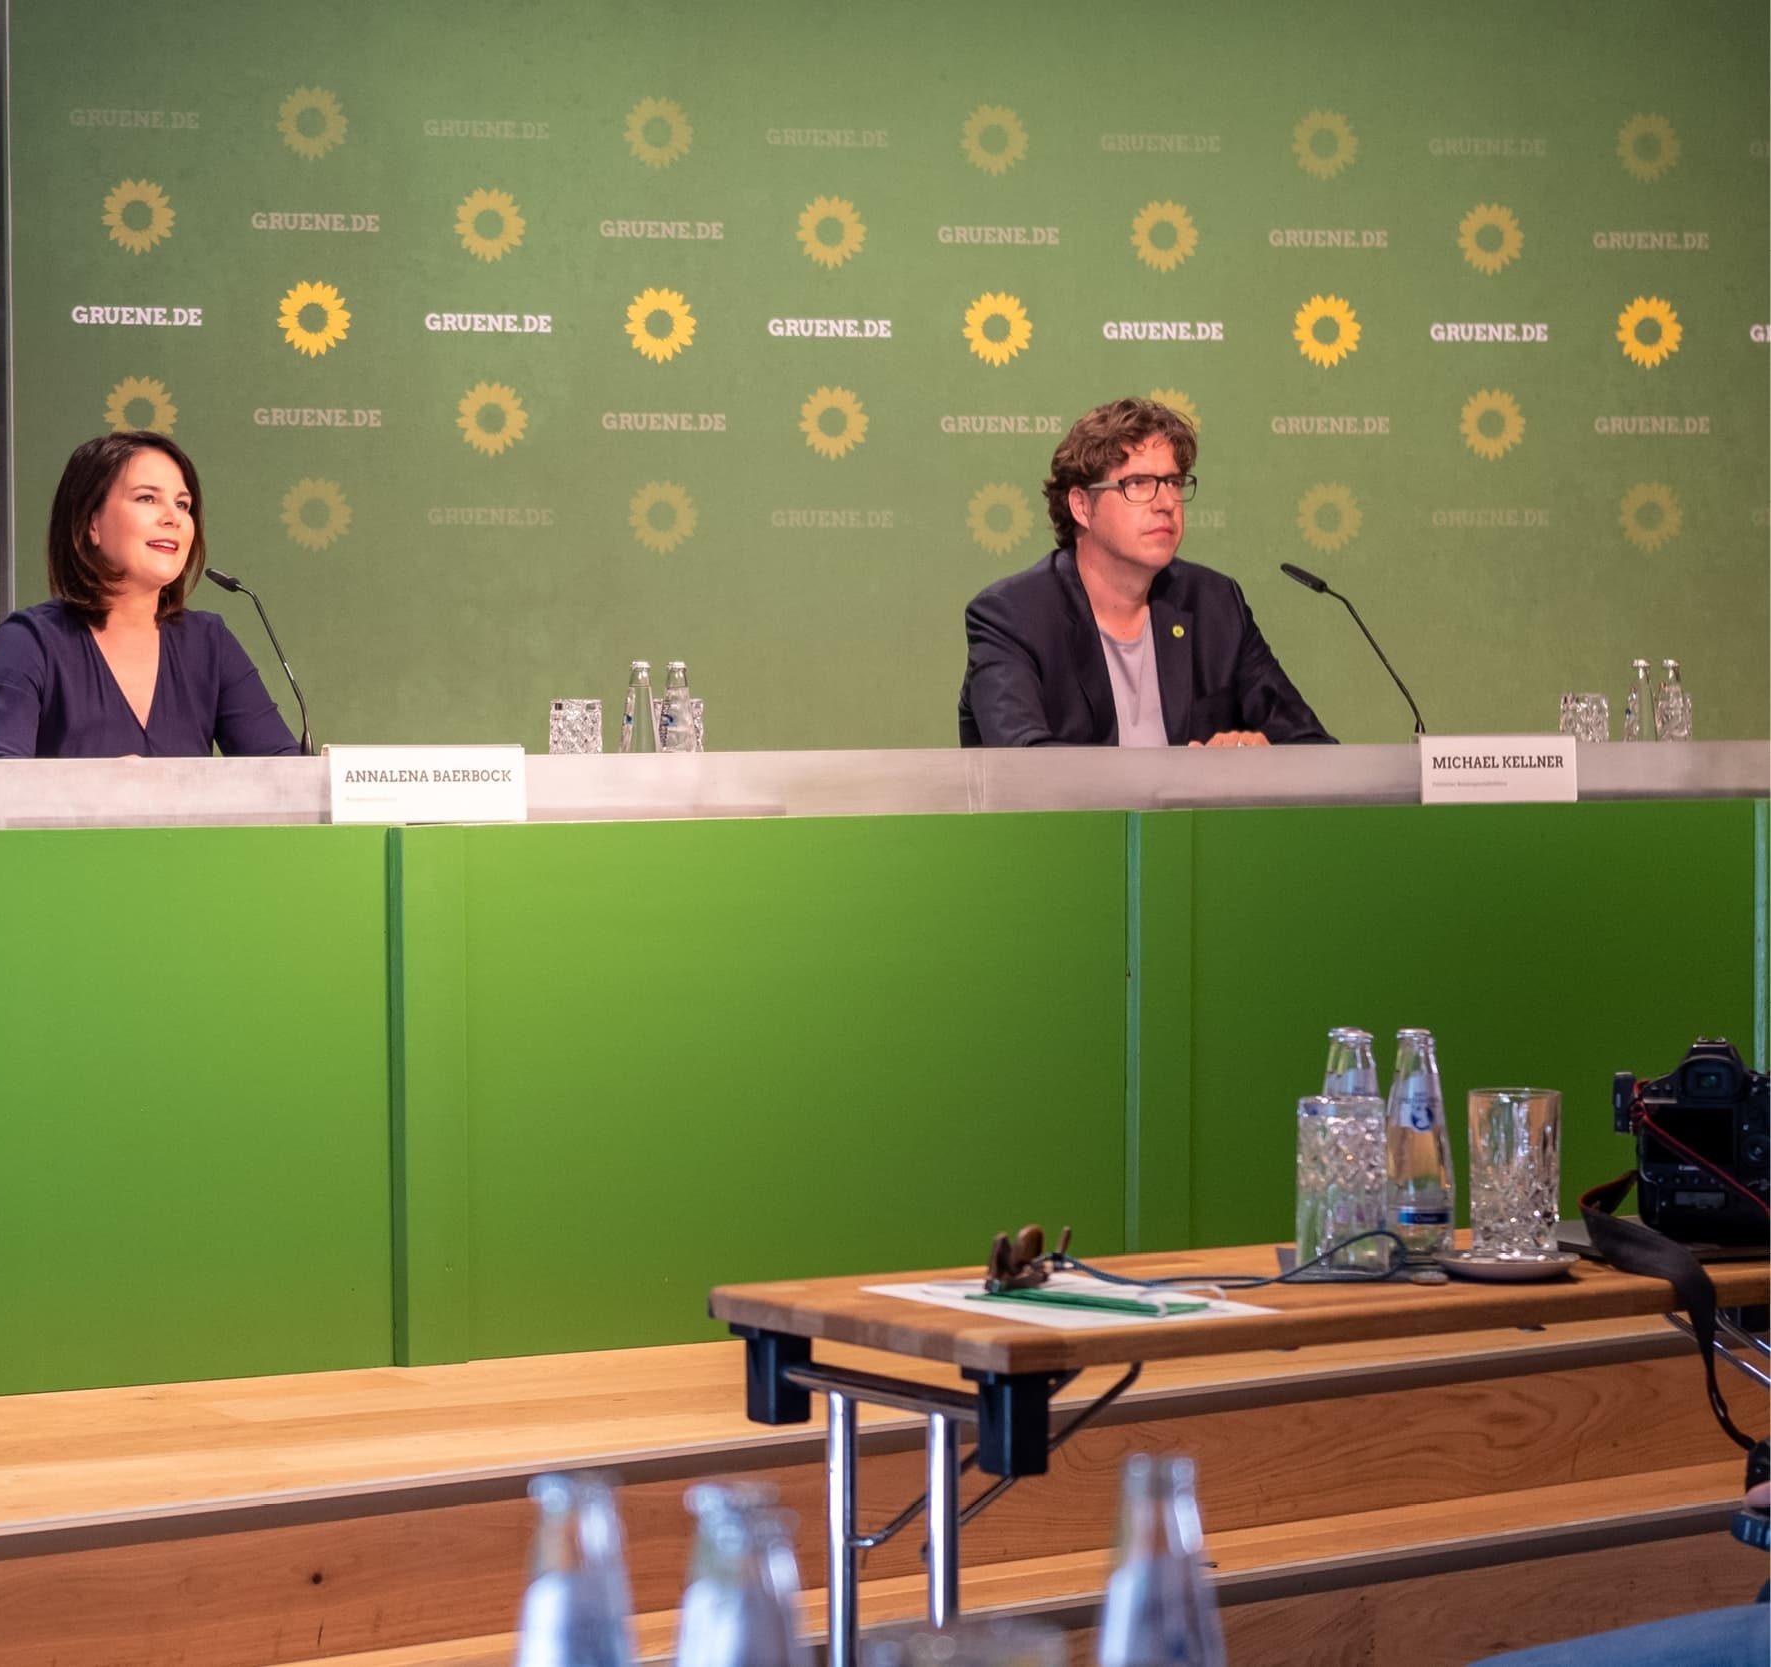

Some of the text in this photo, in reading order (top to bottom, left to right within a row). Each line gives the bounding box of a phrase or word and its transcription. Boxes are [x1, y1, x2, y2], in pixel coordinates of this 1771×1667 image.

[70, 108, 200, 131] GRUENE.DE
[423, 119, 549, 141] GRUENE.DE
[766, 128, 888, 147] GRUENE.DE
[1101, 134, 1221, 154] GRUENE.DE
[252, 213, 380, 234] GRUENE.DE
[600, 221, 724, 241] GRUENE.DE
[938, 226, 1059, 246] GRUENE.DE
[1269, 229, 1388, 249] GRUENE.DE
[1593, 231, 1708, 251] GRUENE.DE
[72, 306, 202, 328] GRUENE.DE
[425, 313, 551, 334] GRUENE.DE
[768, 319, 892, 338] GRUENE.DE
[1103, 322, 1223, 342] GRUENE.DE
[1430, 323, 1548, 343] GRUENE.DE
[253, 408, 382, 428] GRUENE.DE
[602, 413, 726, 433] GRUENE.DE
[940, 415, 1061, 434] GRUENE.DE
[1271, 415, 1390, 434] GRUENE.DE
[1595, 417, 1710, 435] GRUENE.DE
[771, 510, 893, 529] GRUENE.DE
[1432, 755, 1564, 769] MICHAEL KELLNER
[345, 769, 512, 783] ANNALENA BAERBOCK
